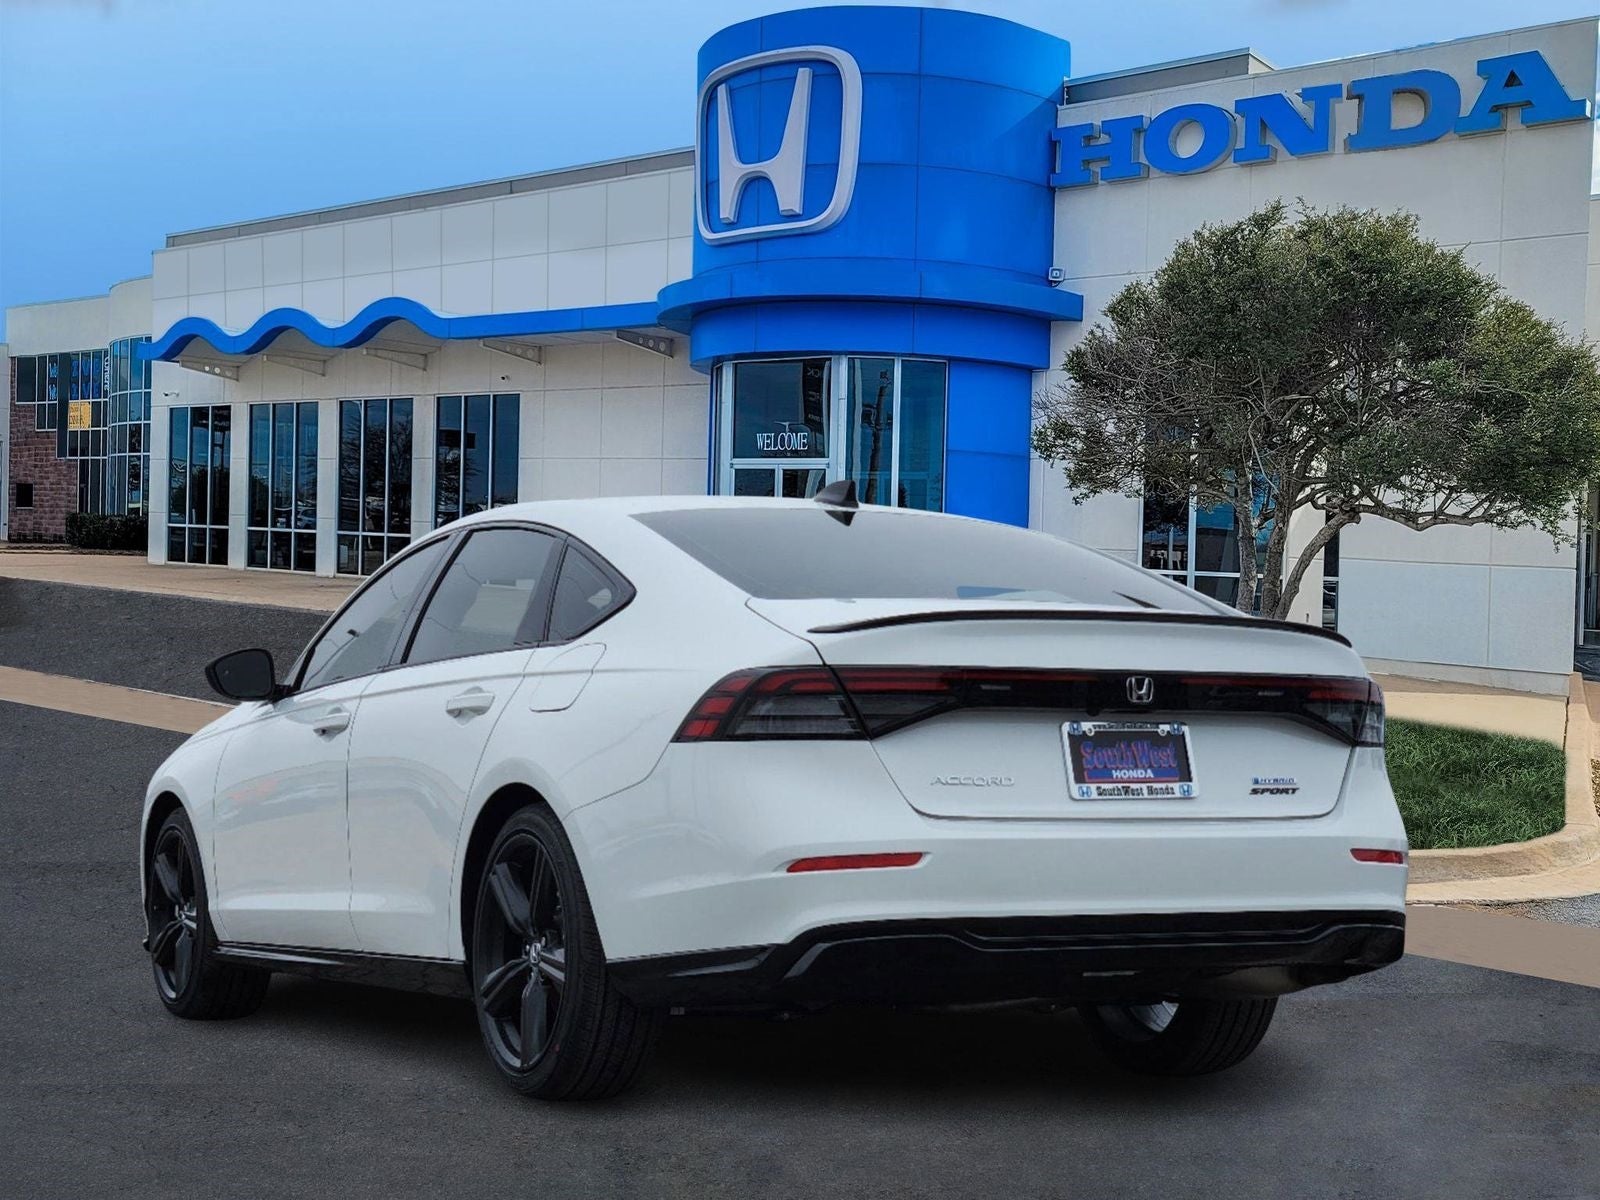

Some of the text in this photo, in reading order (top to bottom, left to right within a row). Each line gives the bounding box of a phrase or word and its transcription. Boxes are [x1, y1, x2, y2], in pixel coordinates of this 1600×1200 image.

[1051, 50, 1593, 187] HONDA
[756, 432, 809, 451] WELCOME
[1112, 769, 1154, 779] HONDA
[930, 775, 1015, 787] ACCORD
[1147, 785, 1176, 796] Honda
[1249, 787, 1300, 795] SPORT
